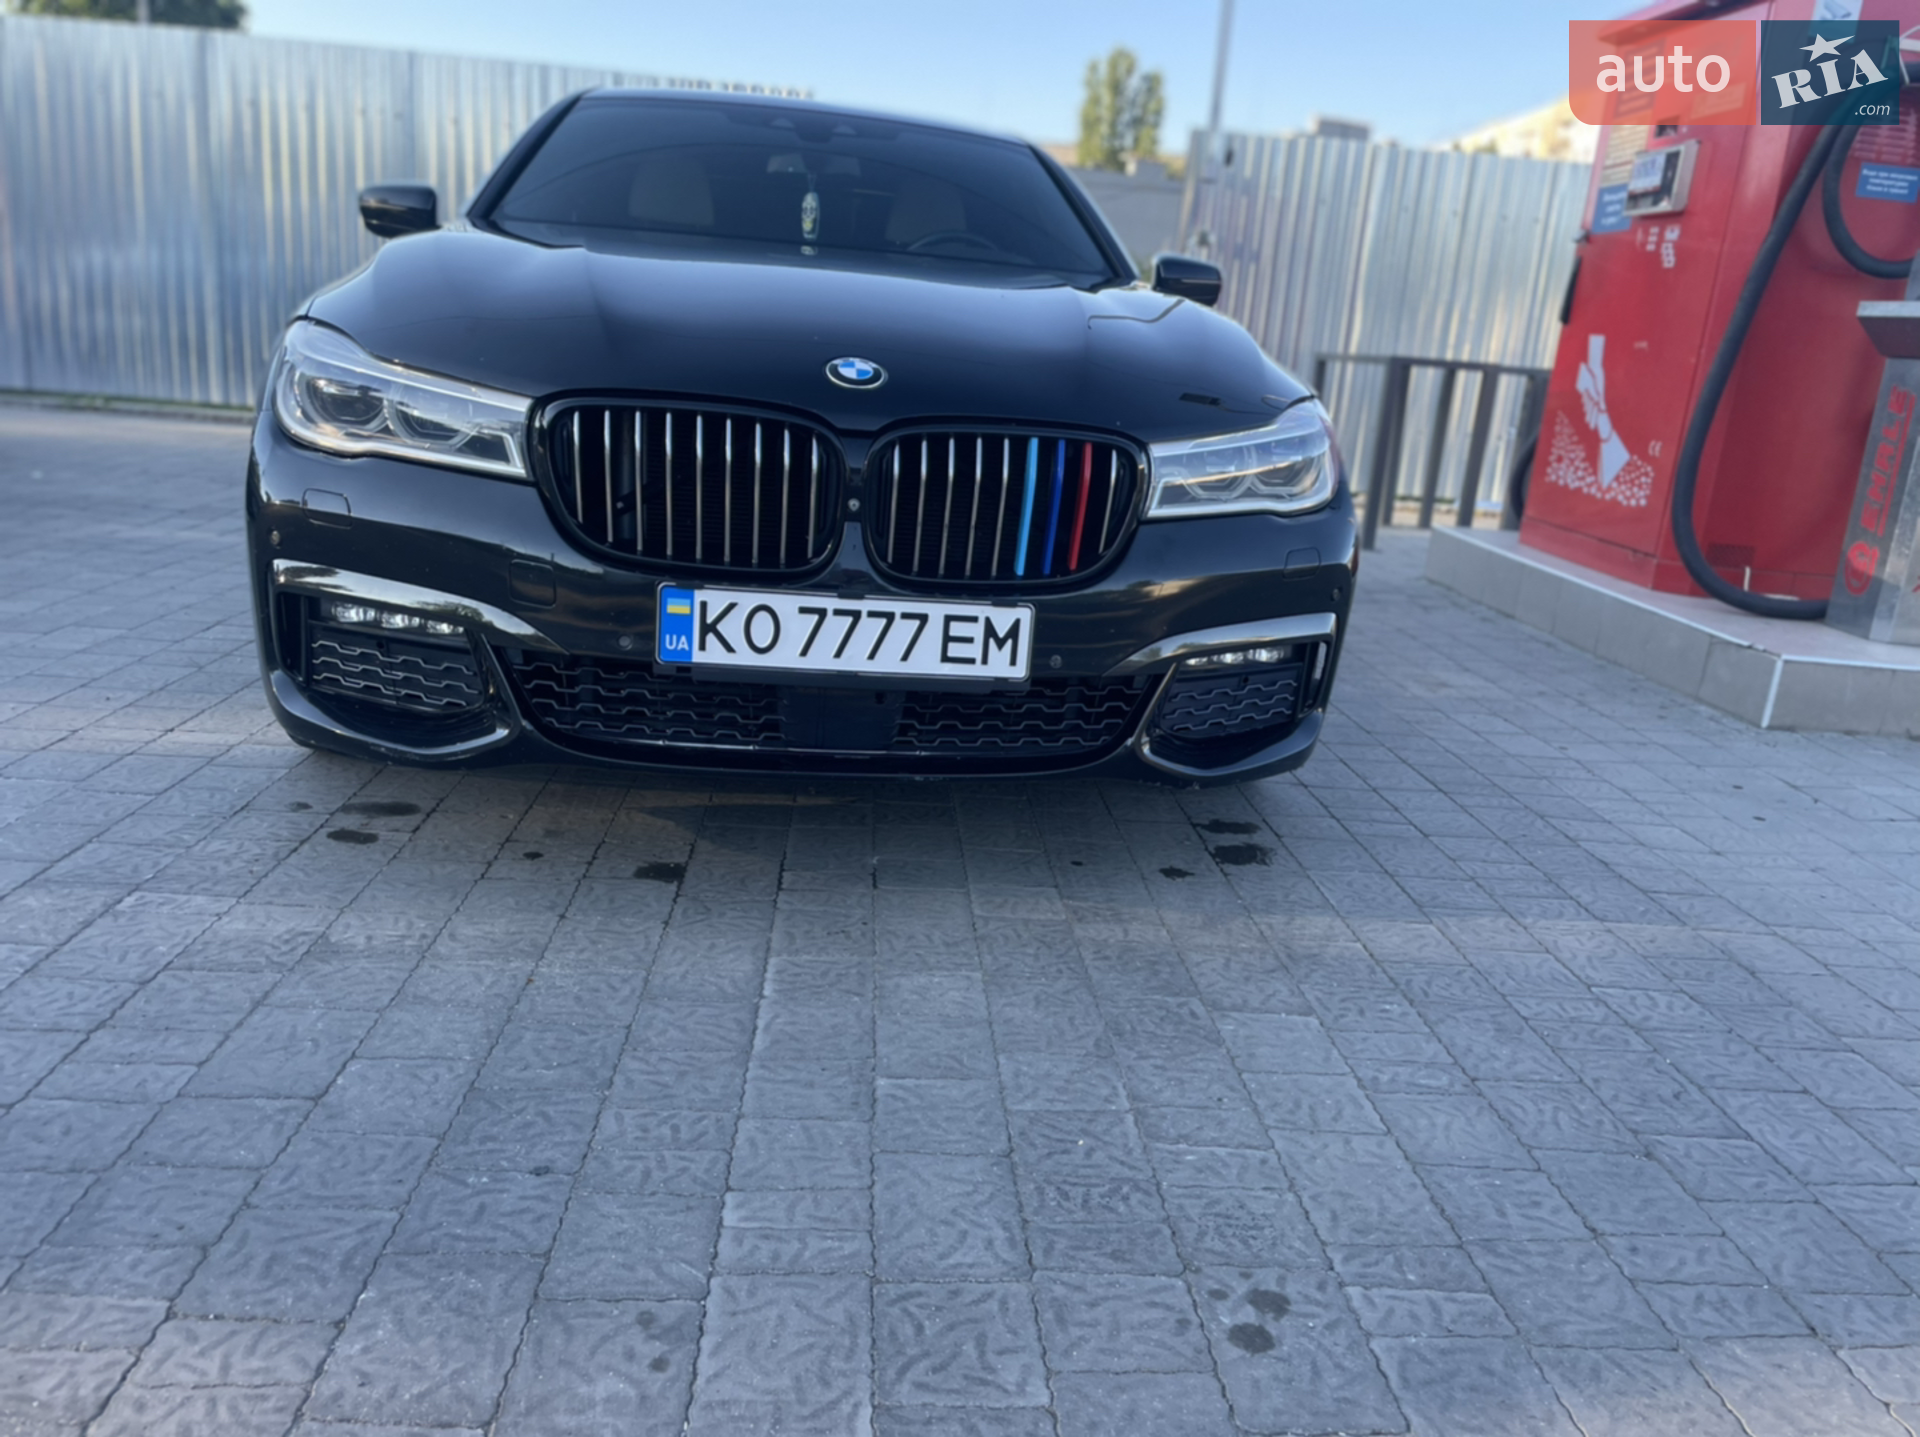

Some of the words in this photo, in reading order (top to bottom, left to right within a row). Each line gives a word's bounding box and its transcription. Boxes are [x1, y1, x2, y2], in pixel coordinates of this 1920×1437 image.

[665, 634, 690, 652] UA
[797, 606, 929, 662] 7777
[940, 614, 1022, 667] EM
